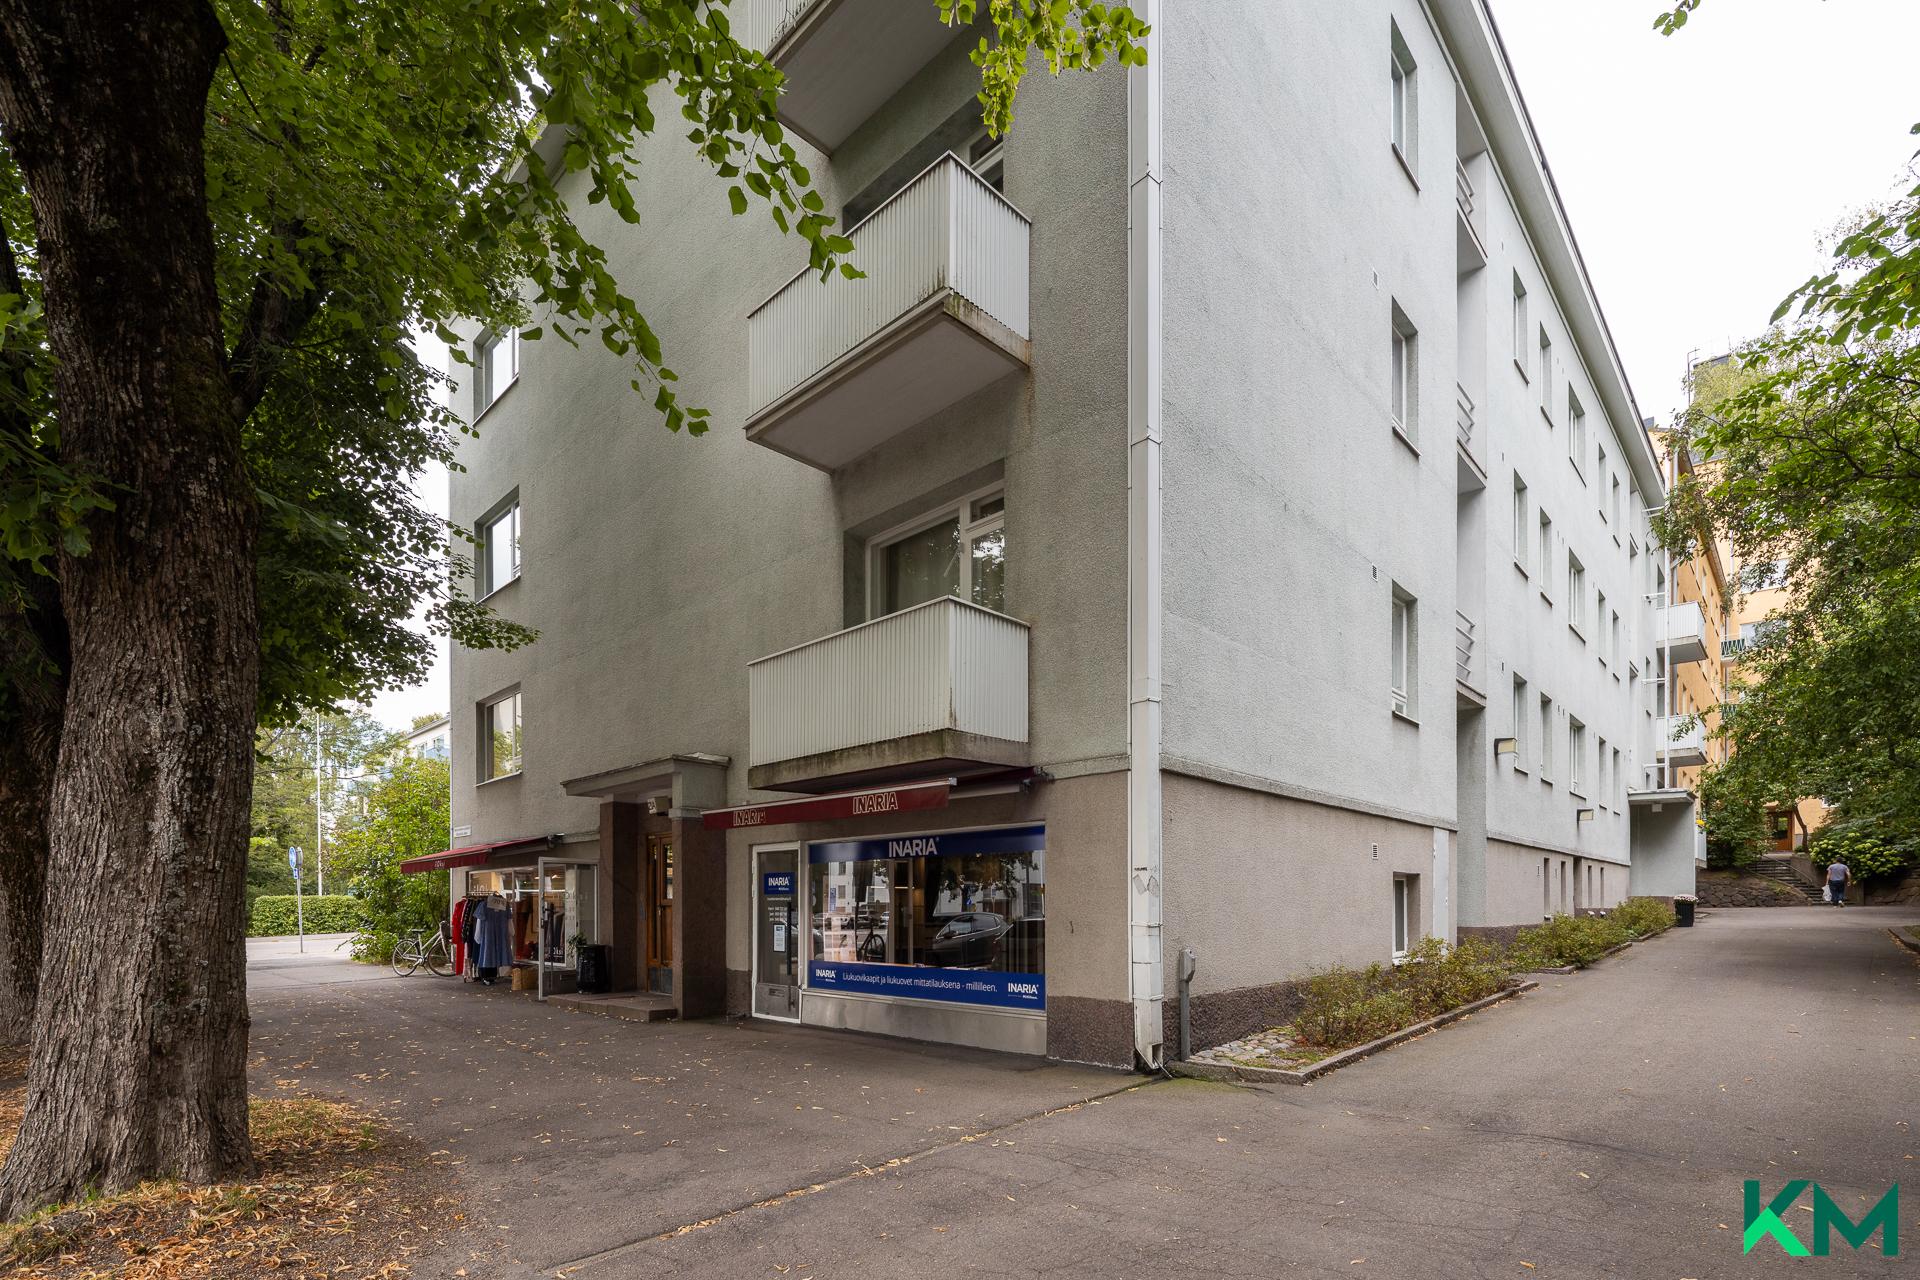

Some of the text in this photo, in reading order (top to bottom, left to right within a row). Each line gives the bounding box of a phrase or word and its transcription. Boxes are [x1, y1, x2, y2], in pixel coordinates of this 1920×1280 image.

[852, 792, 898, 814] INARIA
[733, 809, 766, 826] INARIA
[888, 838, 938, 858] INARIA
[768, 877, 790, 887] INARIA
[815, 968, 836, 978] INARIA
[842, 972, 880, 984] Liukuovikaapit
[880, 976, 886, 985] ja
[887, 975, 913, 986] liukuovet
[913, 977, 961, 990] mittatilauksena
[966, 981, 998, 993] millilleen.
[1007, 982, 1039, 995] INARIA
